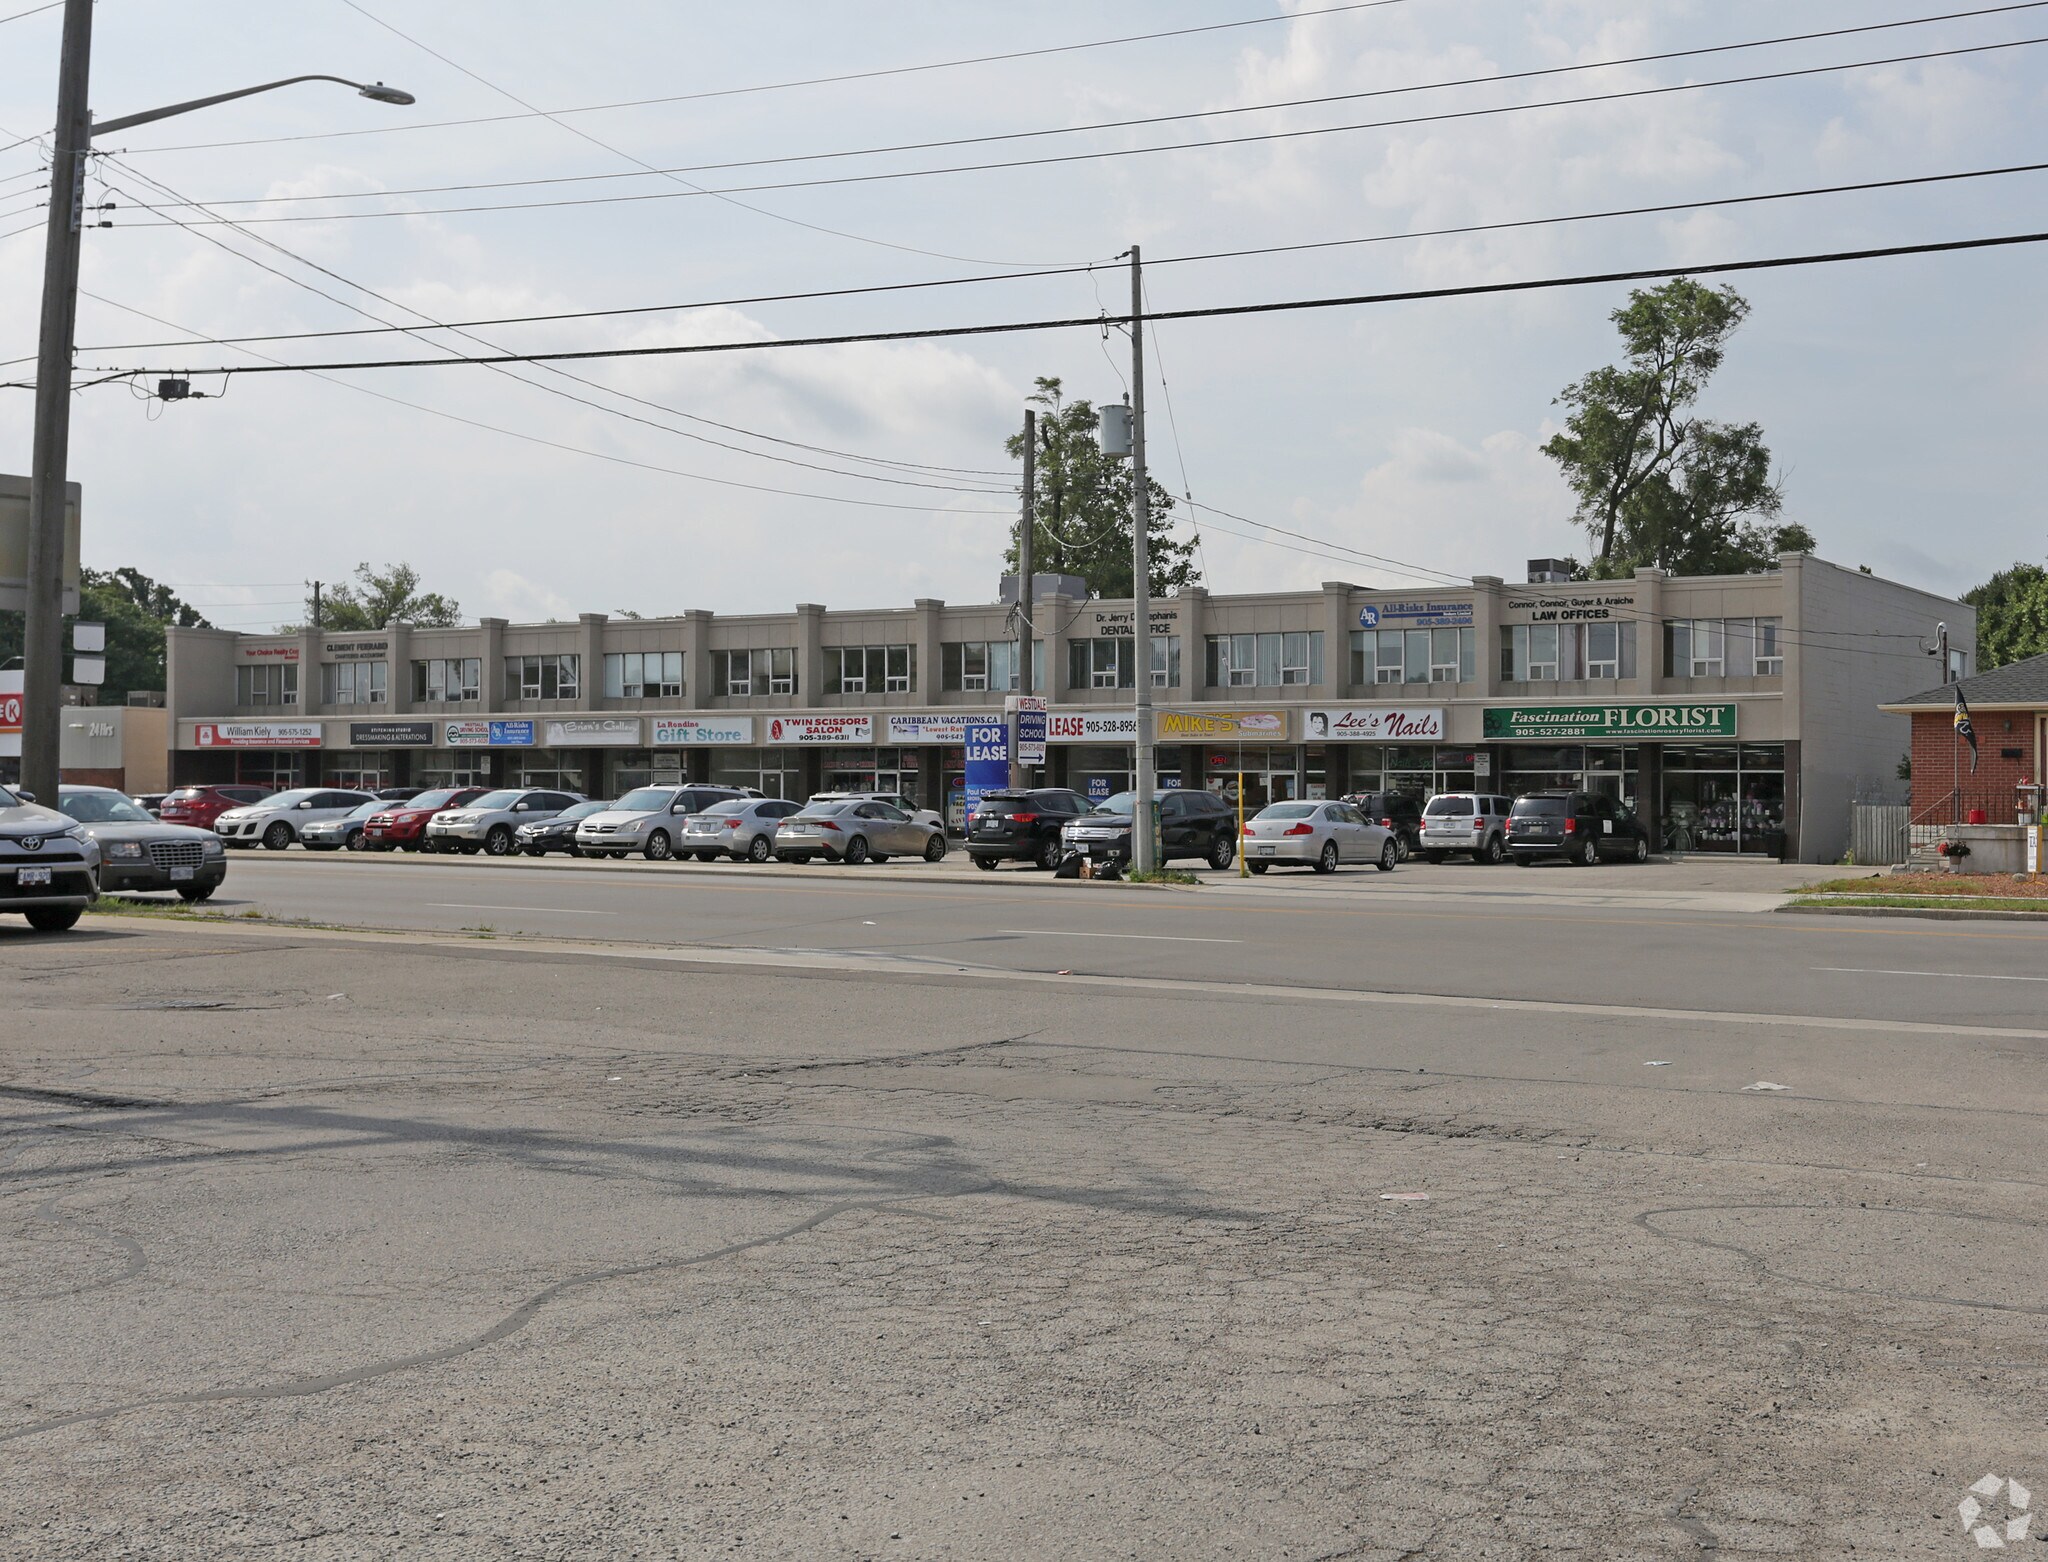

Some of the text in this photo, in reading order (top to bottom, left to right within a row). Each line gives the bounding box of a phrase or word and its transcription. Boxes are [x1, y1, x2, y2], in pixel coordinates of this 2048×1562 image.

[1382, 603, 1473, 613] All-Risks Insurance
[1508, 601, 1538, 609] Connor,
[1540, 600, 1569, 608] Connor,
[1571, 598, 1593, 607] Guyer
[1096, 613, 1106, 622] Dr.
[1109, 613, 1128, 623] Jerry
[1532, 609, 1609, 620] LAW OFFICES
[1101, 625, 1135, 635] DENTAL
[326, 644, 355, 652] CLEMENT
[1019, 698, 1047, 711] WESTDALE
[815, 717, 868, 726] SCISSORS
[891, 716, 940, 725] CARIBBEAN
[1020, 715, 1046, 725] DRIVING
[1510, 711, 1600, 723] Fascination
[1602, 707, 1725, 727] FLORIST
[1049, 717, 1084, 736] LEASE
[1163, 713, 1235, 733] MIKE'S
[1333, 712, 1439, 737] Lee's Nails
[227, 726, 253, 736] William
[255, 726, 271, 738] Kiely
[657, 728, 742, 742] Gift Store
[806, 726, 843, 734] SALON
[1019, 728, 1045, 739] SCHOOL
[1515, 728, 1585, 736] 905-527-2881
[355, 733, 390, 741] DRESSMAKING
[396, 733, 427, 741] ALTERATIONS
[972, 728, 1001, 743] FOR
[966, 746, 1007, 761] LEASE
[1091, 779, 1107, 788] FOR
[1167, 779, 1182, 788] FOR
[1088, 787, 1110, 796] LEASE
